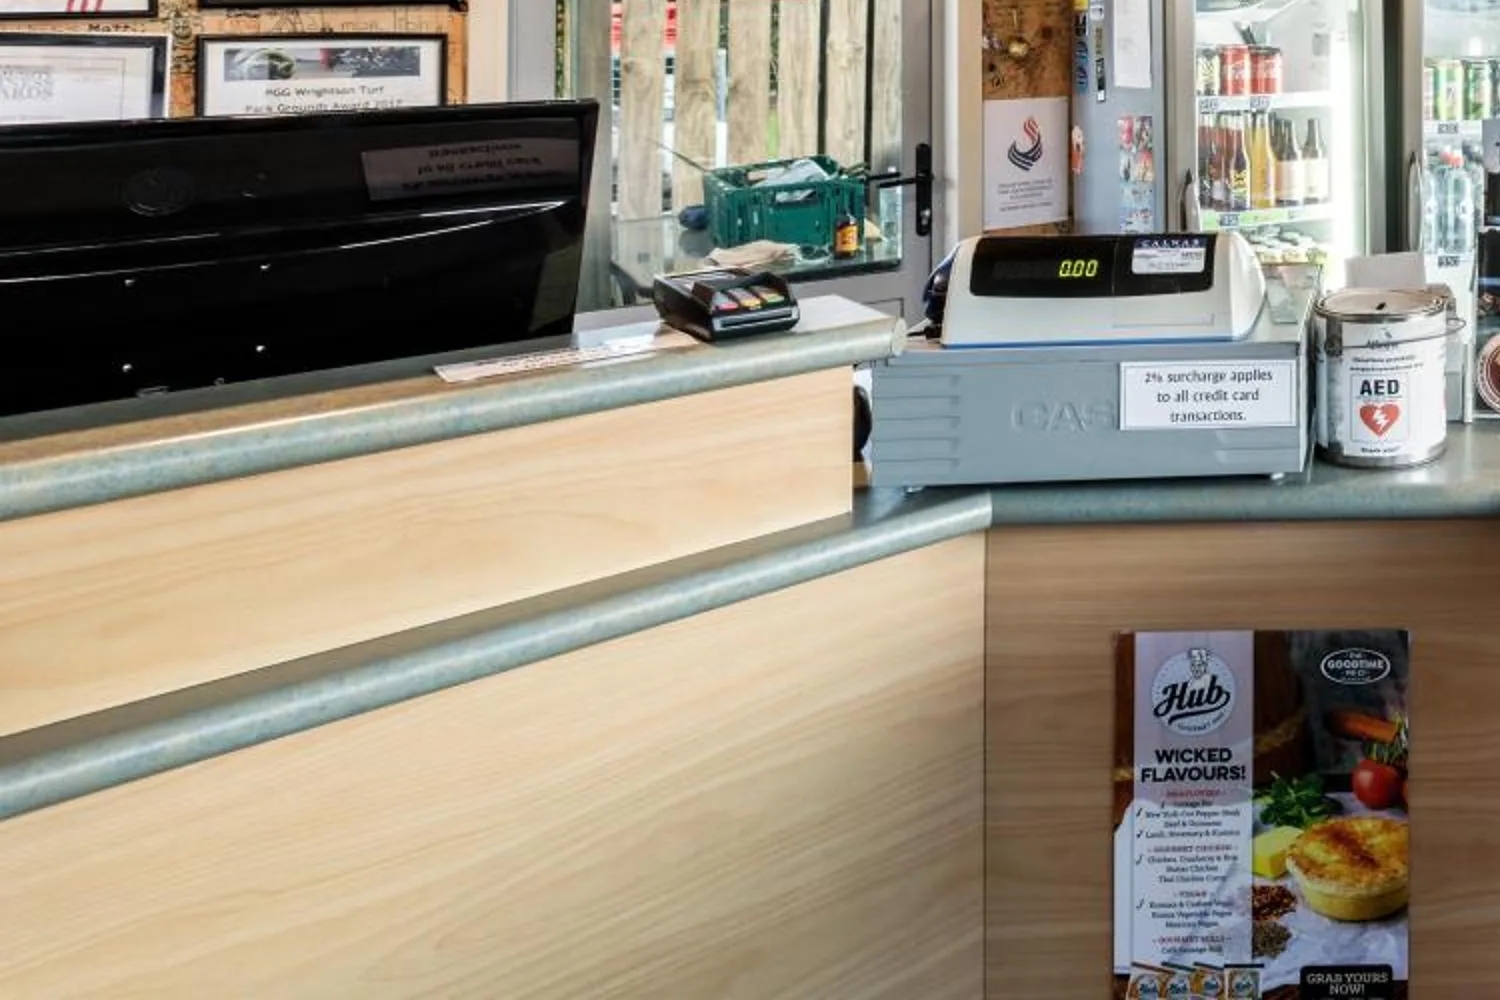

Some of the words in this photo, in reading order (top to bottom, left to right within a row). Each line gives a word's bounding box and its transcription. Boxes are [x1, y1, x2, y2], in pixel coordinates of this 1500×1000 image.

[294, 86, 355, 98] Wrightson
[360, 85, 385, 95] Turf
[1058, 259, 1099, 277] 0.00
[1144, 372, 1163, 383] 2%
[1167, 369, 1226, 385] surcharge
[1229, 369, 1273, 384] applies
[1157, 391, 1171, 403] to
[1174, 389, 1189, 403] all
[1193, 389, 1229, 402] credit
[1232, 388, 1260, 401] card
[1360, 379, 1399, 396] AED
[1170, 409, 1247, 423] transactions.
[1153, 675, 1231, 724] Hub
[1154, 747, 1233, 764] WICKED
[1140, 765, 1247, 783] FLAVOURS!
[1306, 972, 1343, 985] GRAB
[1344, 971, 1389, 984] YOURS
[1329, 983, 1365, 996] NOW!
